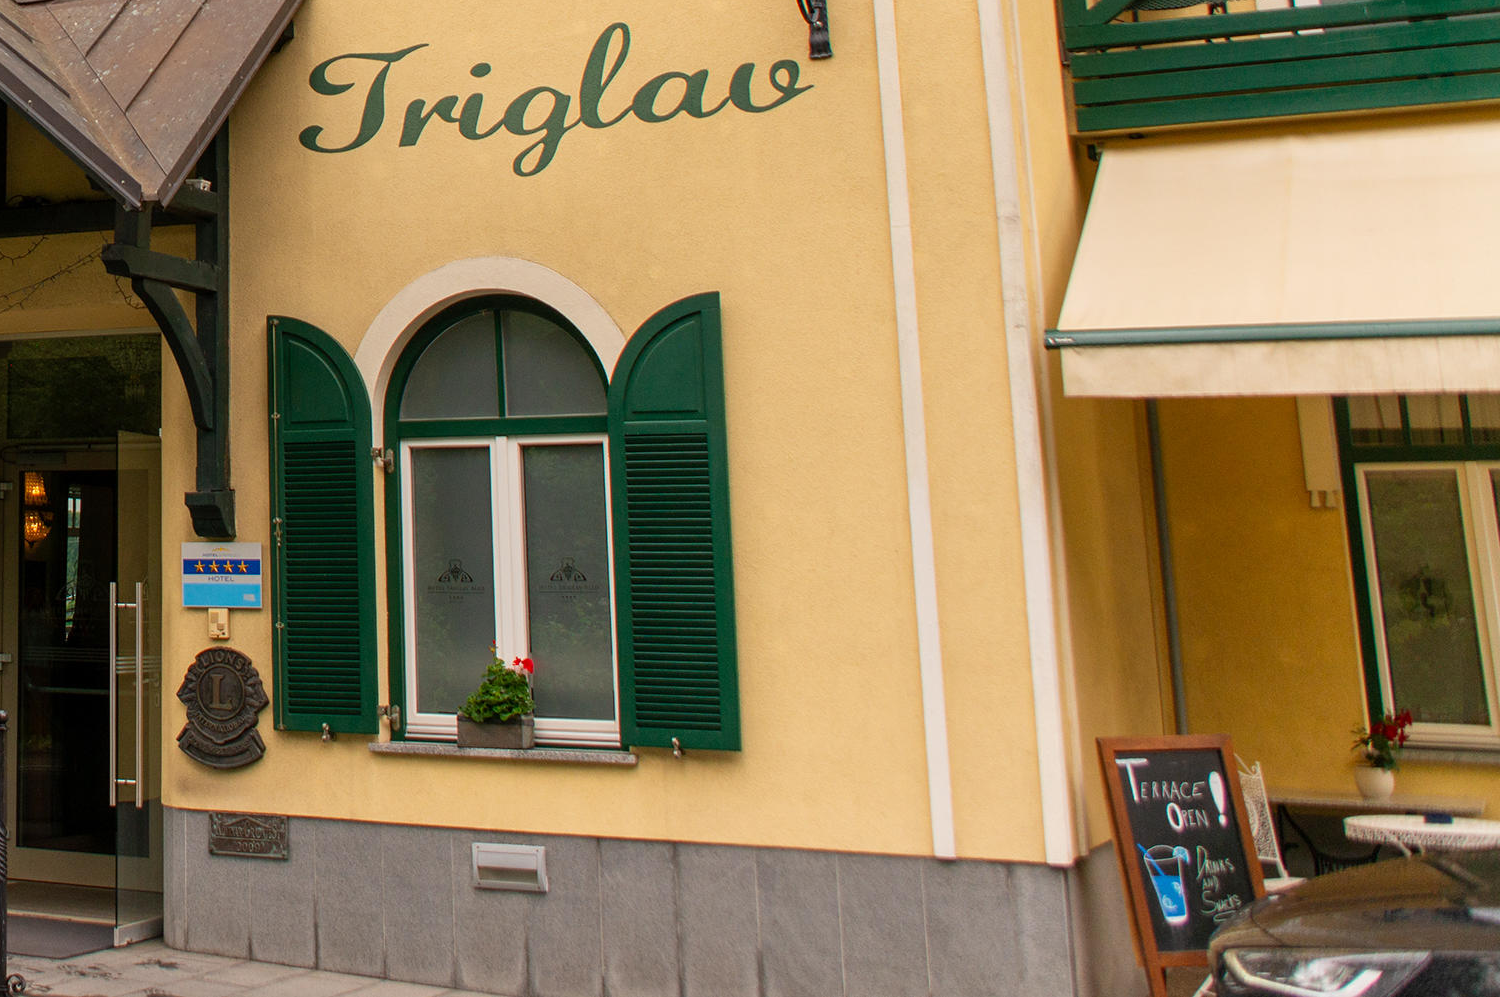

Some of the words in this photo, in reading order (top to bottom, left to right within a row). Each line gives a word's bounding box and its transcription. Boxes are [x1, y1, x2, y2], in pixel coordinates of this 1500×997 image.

[299, 22, 814, 177] Triglav
[200, 650, 245, 670] LIONS
[209, 674, 233, 710] L
